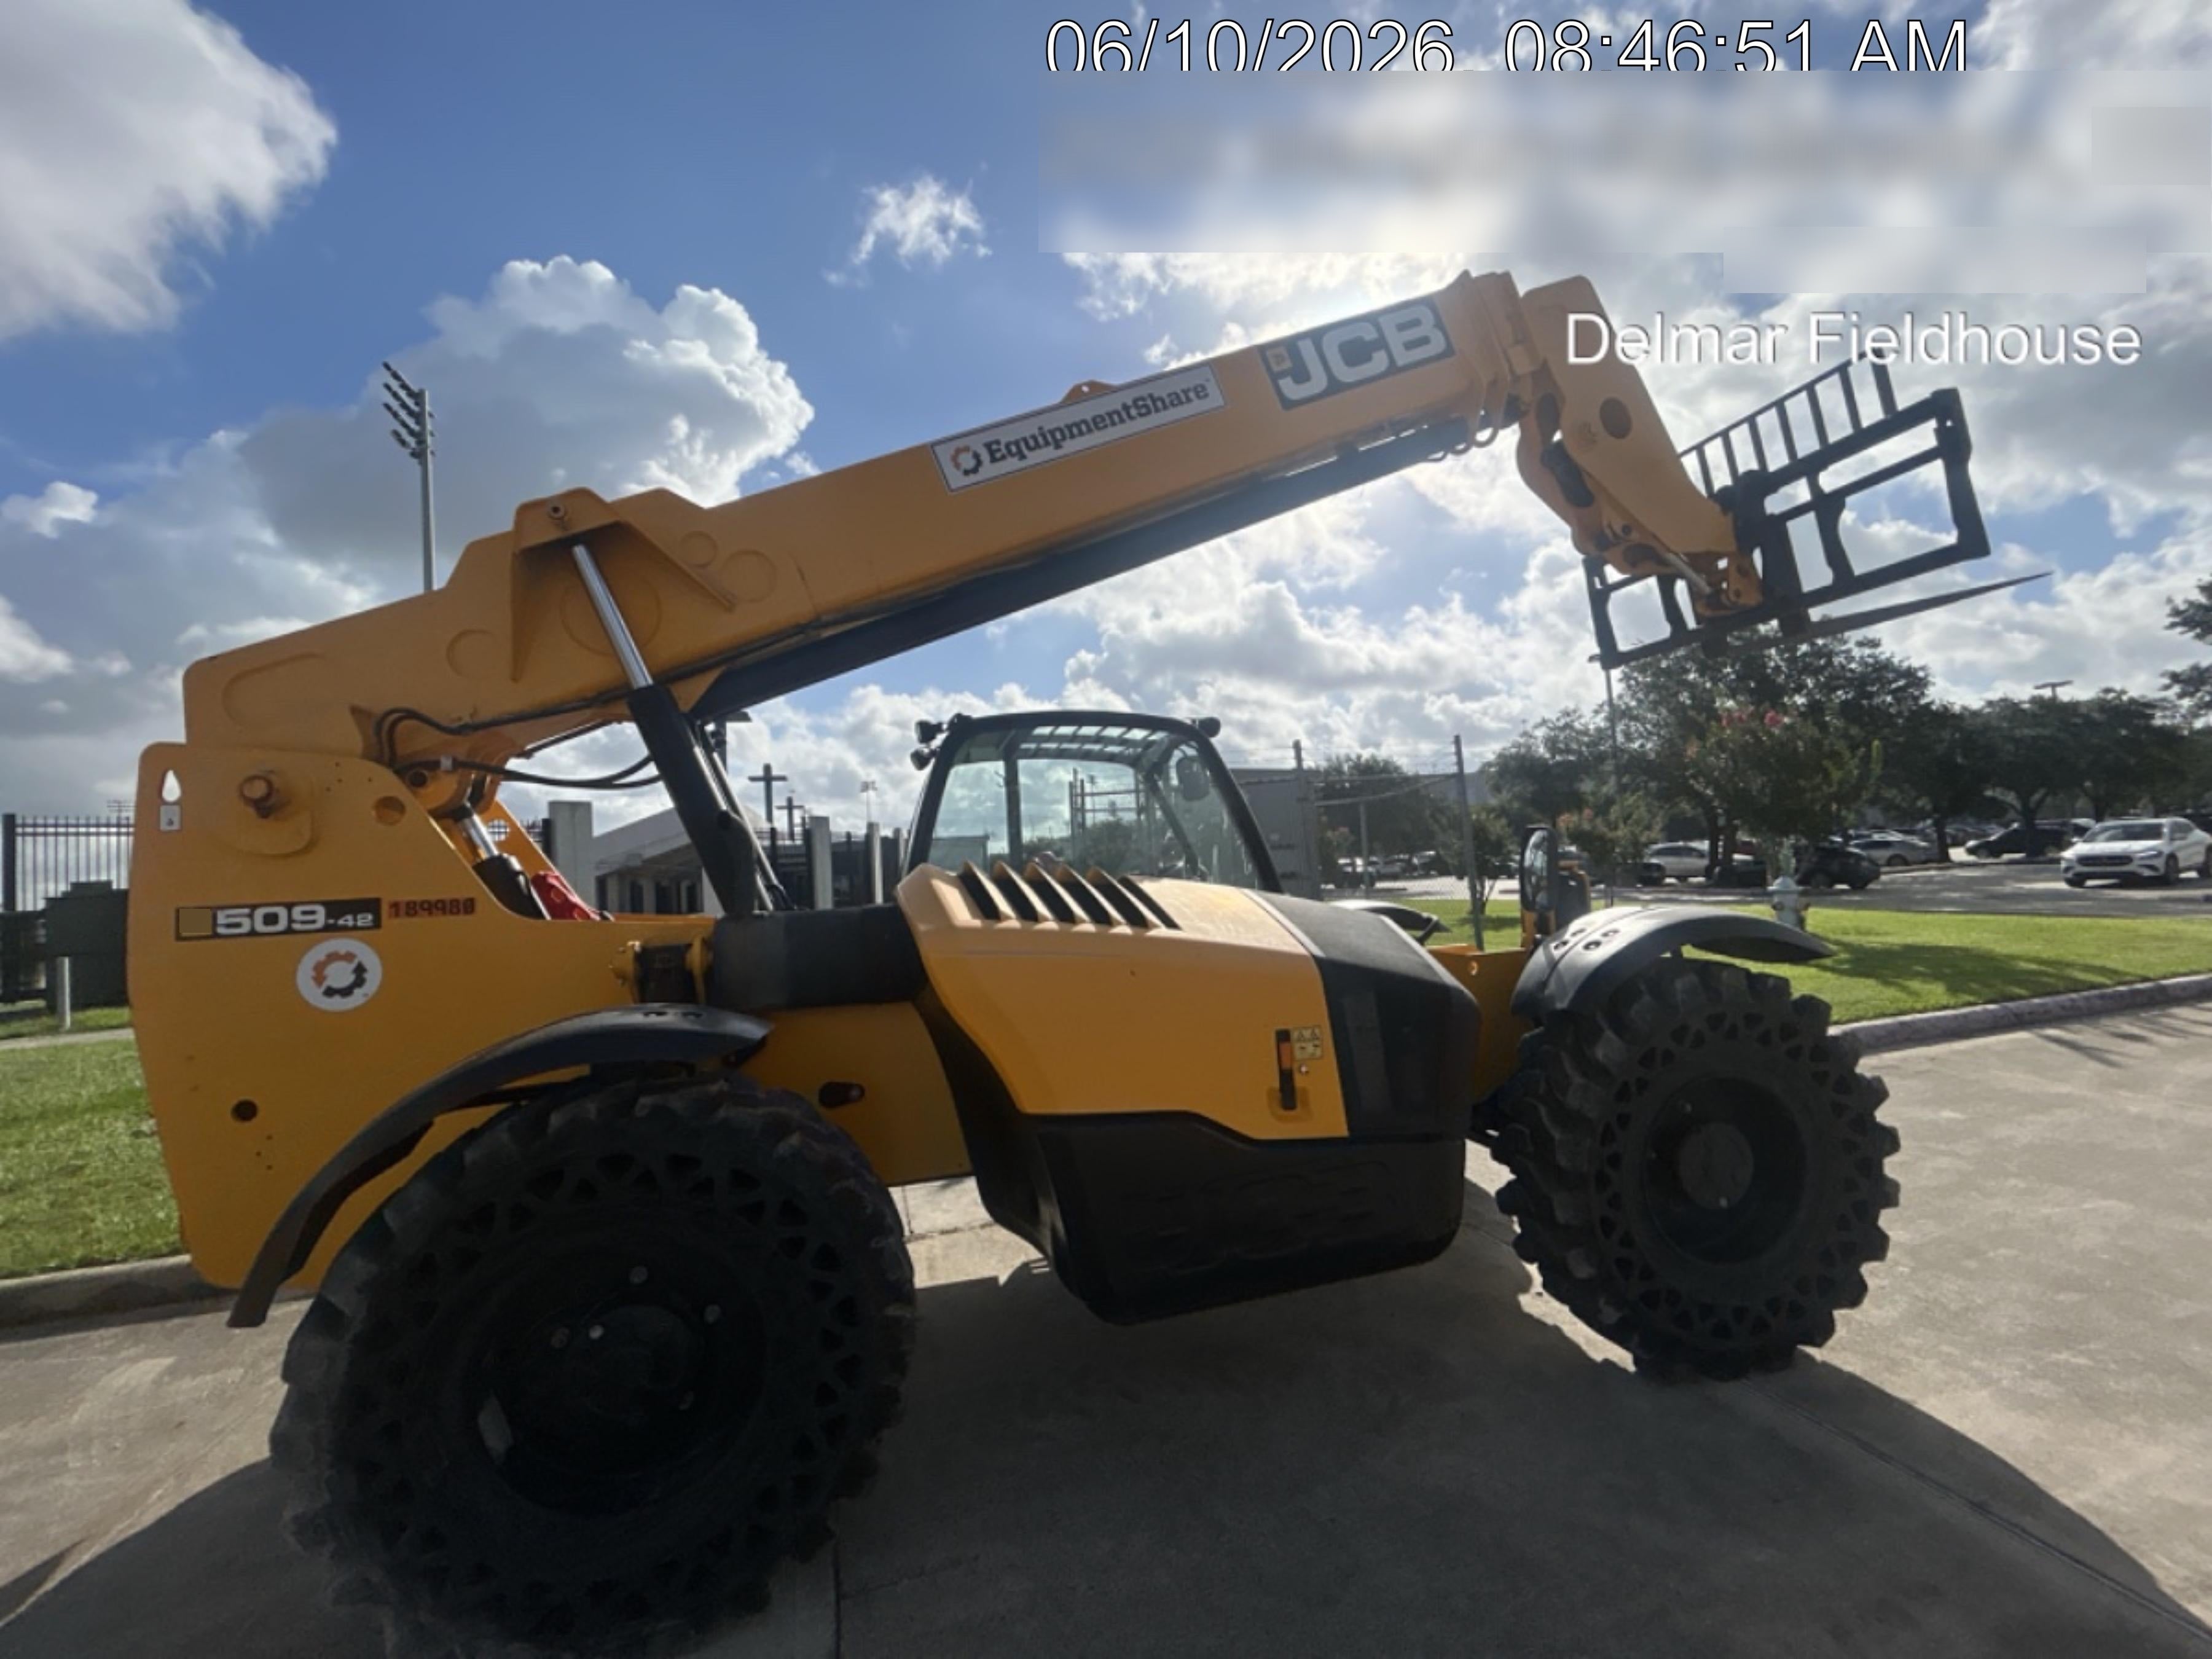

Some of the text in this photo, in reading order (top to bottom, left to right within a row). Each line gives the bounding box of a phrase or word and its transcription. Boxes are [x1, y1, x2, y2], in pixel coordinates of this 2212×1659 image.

[1278, 305, 1446, 401] JCB
[983, 382, 1210, 464] EquipmentShare
[216, 904, 373, 935] 509-42
